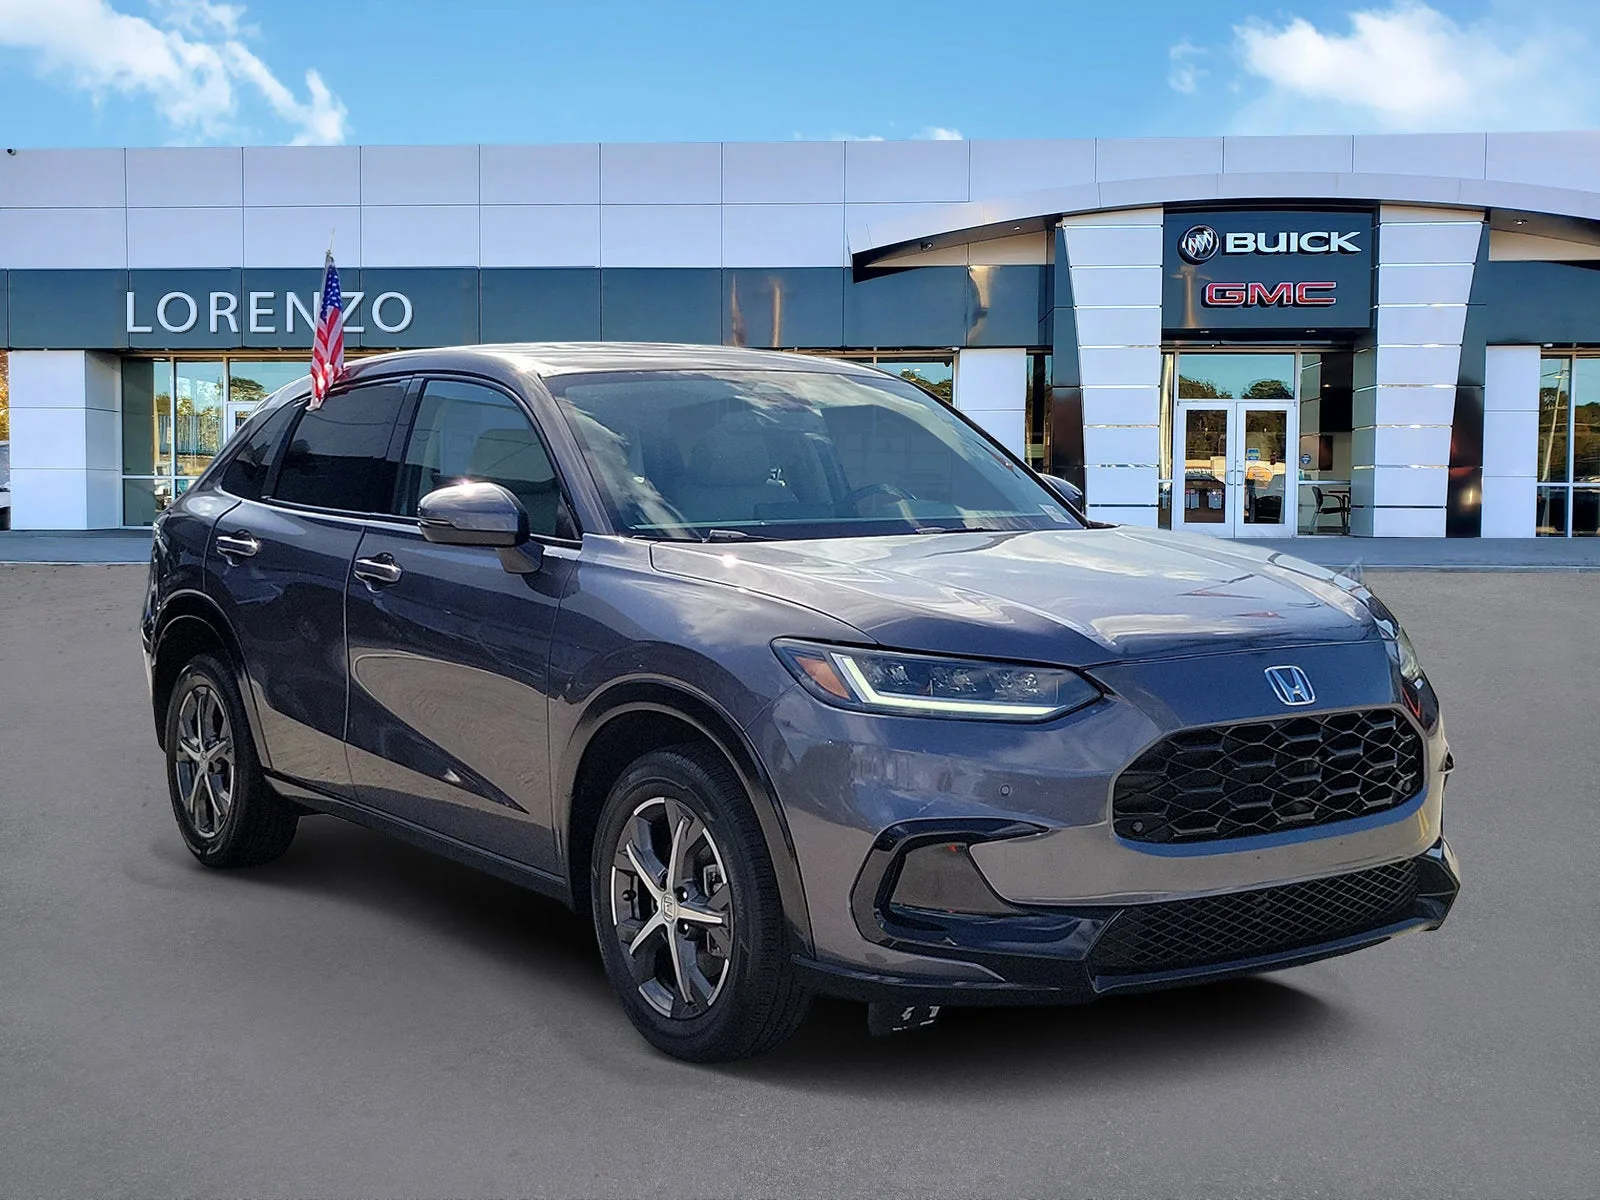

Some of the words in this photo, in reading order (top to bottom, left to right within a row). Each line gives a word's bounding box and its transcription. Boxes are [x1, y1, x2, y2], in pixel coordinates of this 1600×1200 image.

[1225, 231, 1362, 254] BUICK
[1205, 282, 1337, 305] GMC
[126, 291, 413, 333] LORENZO
